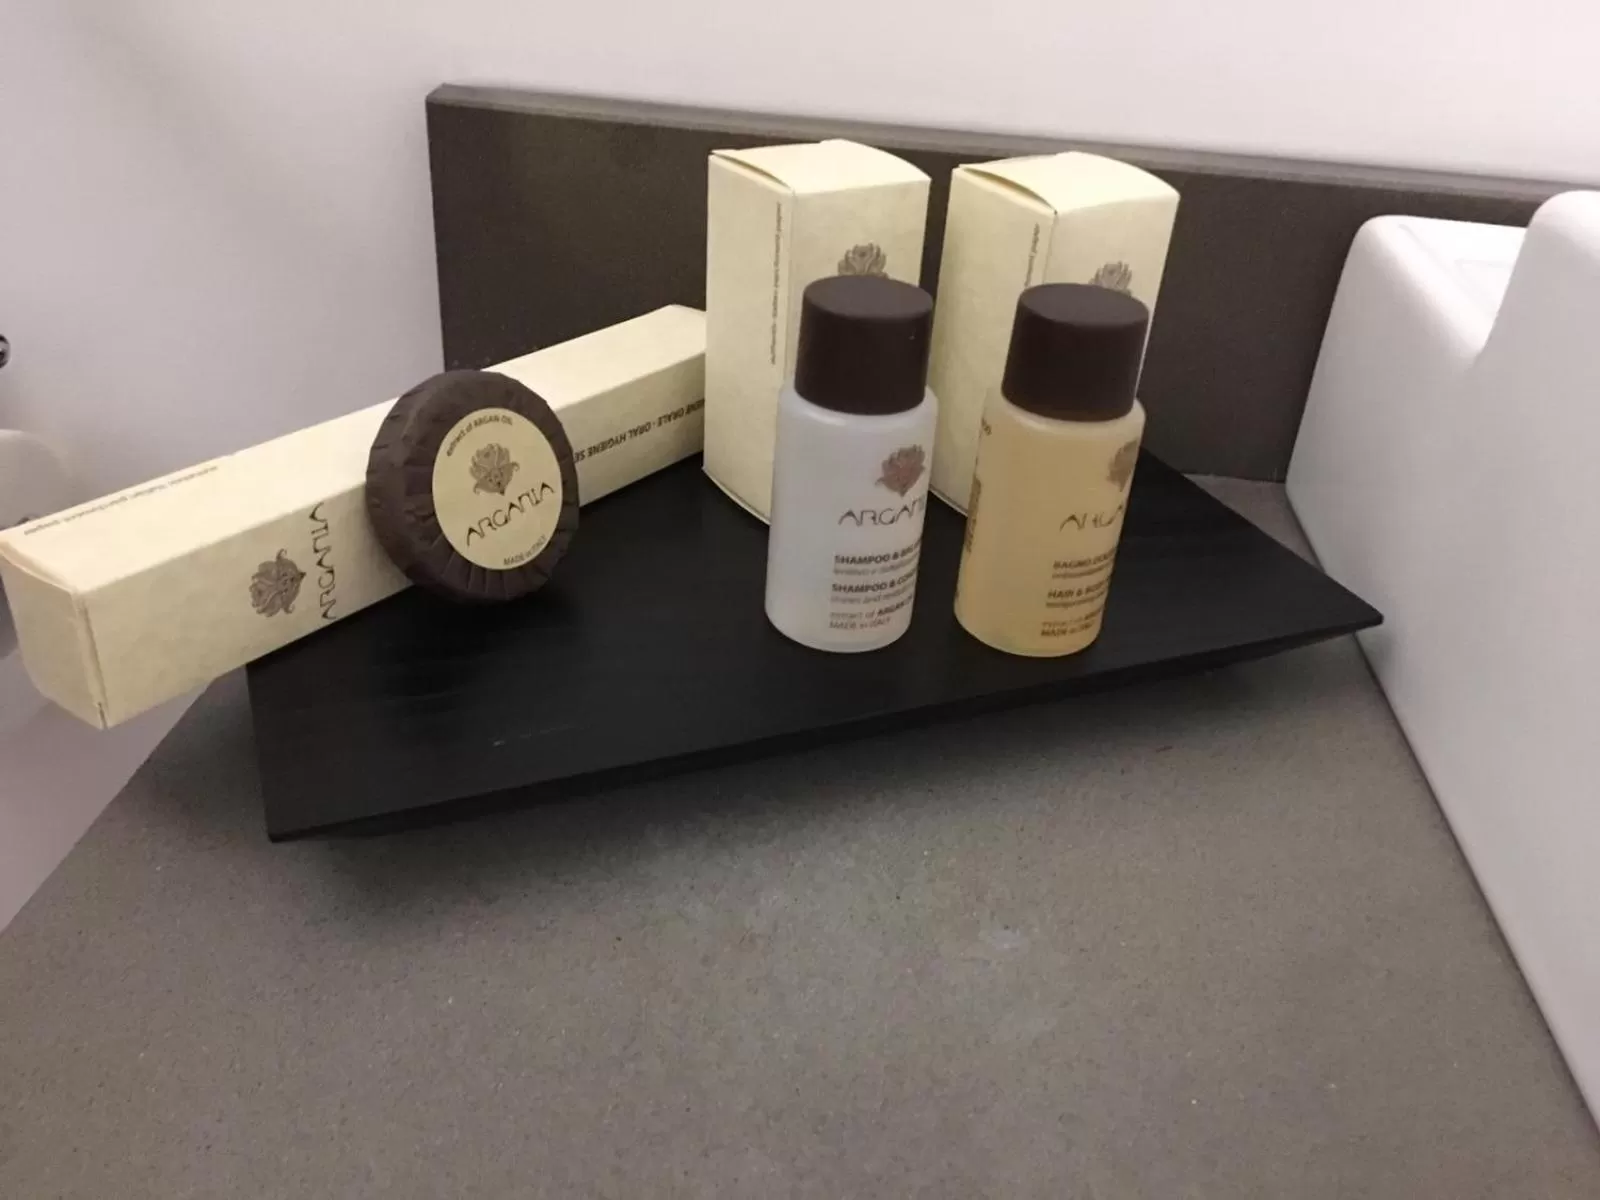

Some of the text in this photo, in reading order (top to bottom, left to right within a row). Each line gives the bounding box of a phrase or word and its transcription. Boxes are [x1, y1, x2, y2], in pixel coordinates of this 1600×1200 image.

[473, 414, 500, 428] ARGAN
[628, 421, 651, 439] ORAL
[587, 432, 626, 458] HYGIENE
[574, 449, 586, 463] SE
[466, 481, 556, 547] ARGANIA
[308, 501, 337, 620] ARGANIA
[503, 554, 525, 566] MADE
[834, 552, 891, 565] SHAMPOO
[892, 551, 899, 561] &
[831, 581, 888, 594] SHAMPOO
